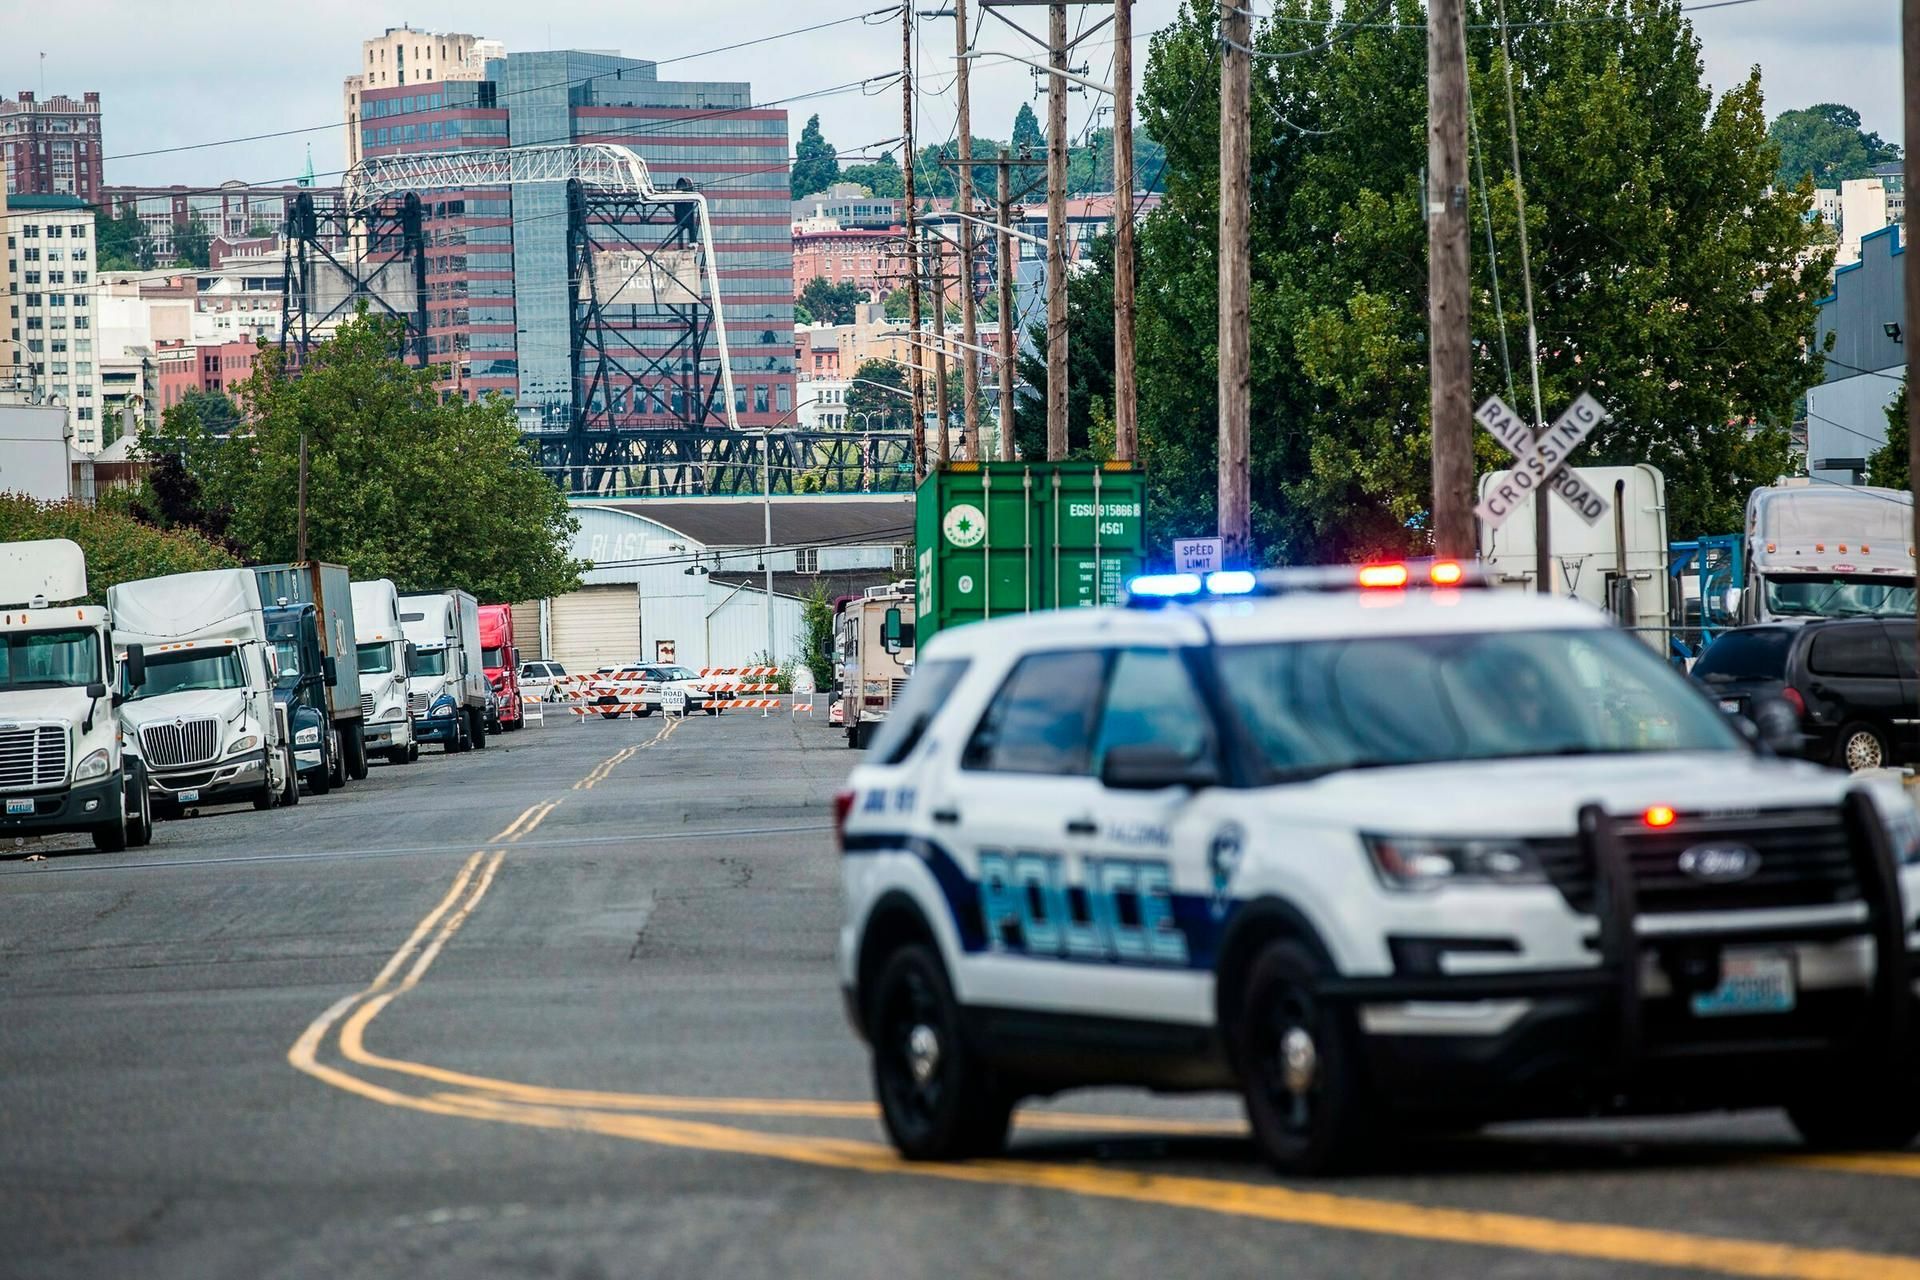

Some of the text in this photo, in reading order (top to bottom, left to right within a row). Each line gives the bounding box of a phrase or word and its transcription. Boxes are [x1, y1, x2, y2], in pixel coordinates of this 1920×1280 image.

[1482, 403, 1603, 518] RAIL ROAD
[1488, 405, 1594, 517] CROSSING
[1070, 504, 1096, 517] EGSU
[1100, 523, 1124, 535] 45G1
[1183, 544, 1214, 555] SPEED
[1186, 558, 1210, 569] LIMIT
[661, 697, 684, 705] CLOSED
[977, 846, 1191, 966] POLICE
